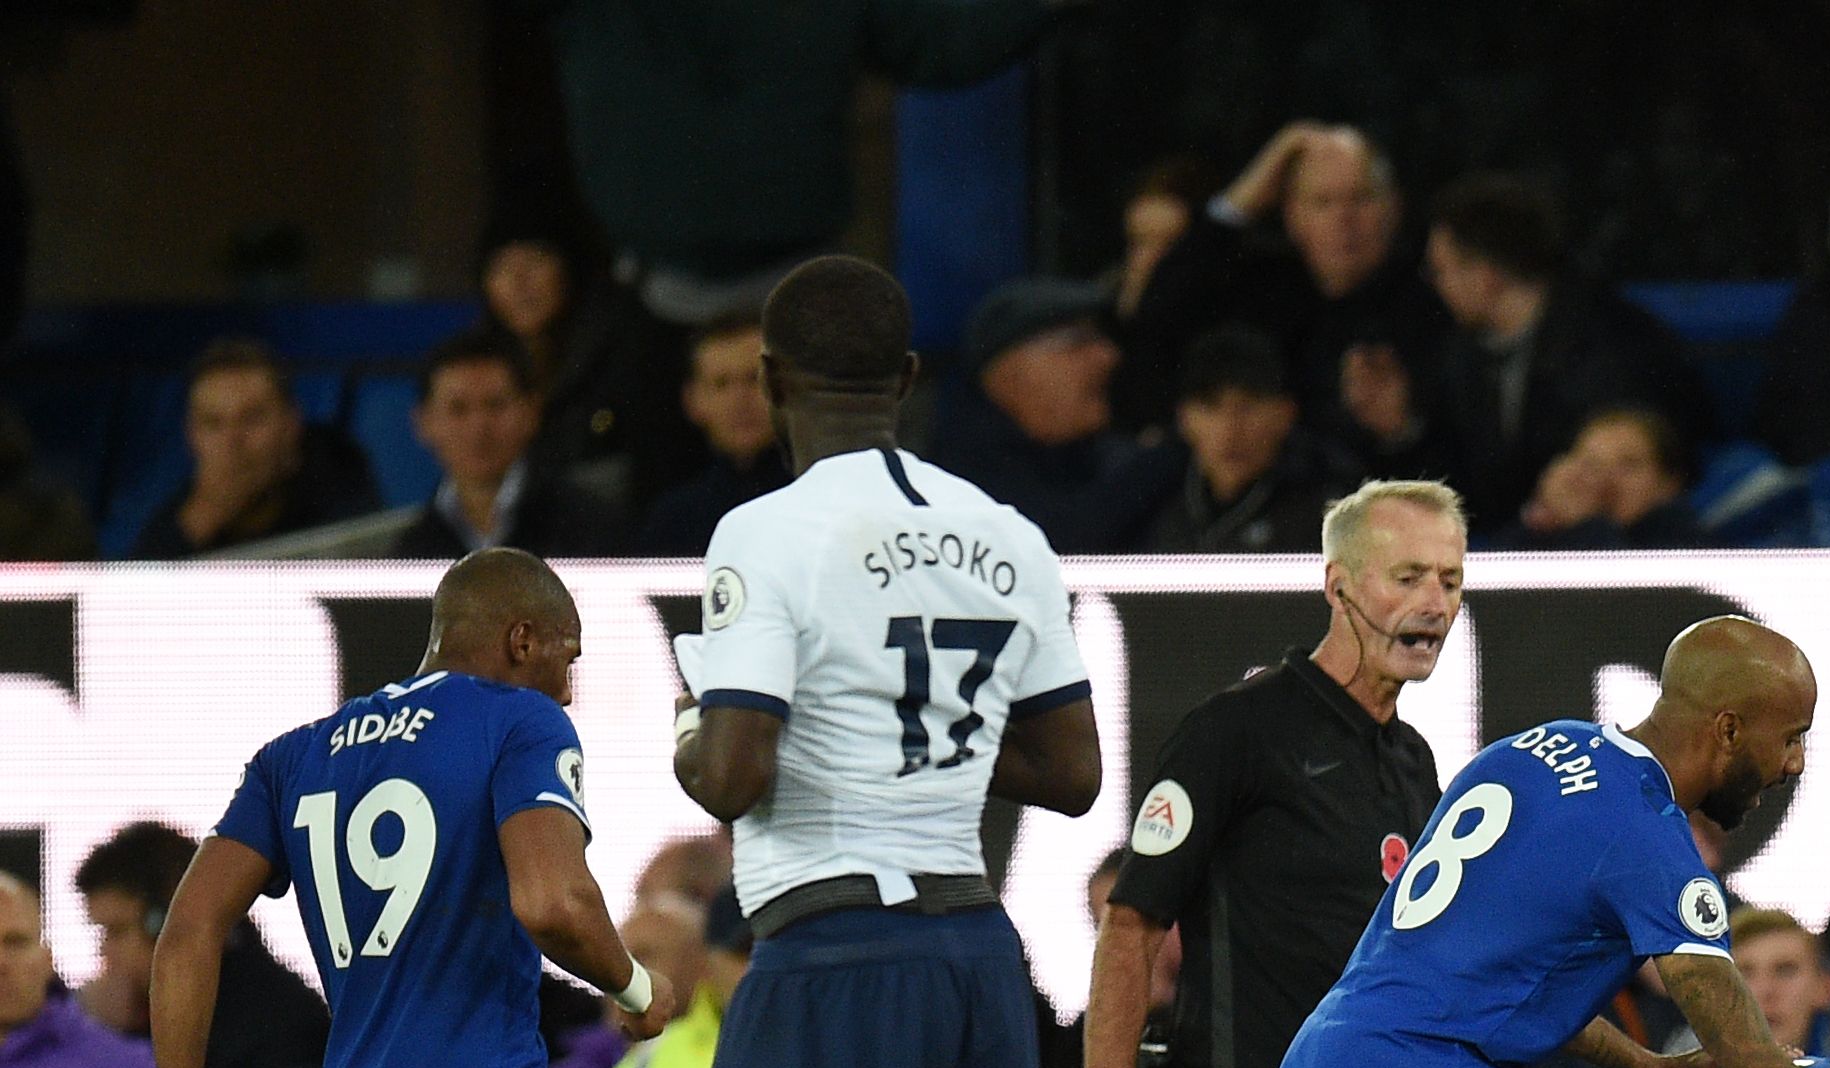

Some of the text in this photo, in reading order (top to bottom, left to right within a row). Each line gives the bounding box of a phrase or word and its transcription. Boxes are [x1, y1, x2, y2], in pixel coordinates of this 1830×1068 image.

[865, 531, 1017, 597] SISSOKO
[884, 615, 1019, 778] 17
[1511, 727, 1599, 796] DELPH
[293, 778, 437, 969] 19
[1392, 783, 1513, 930] 8
